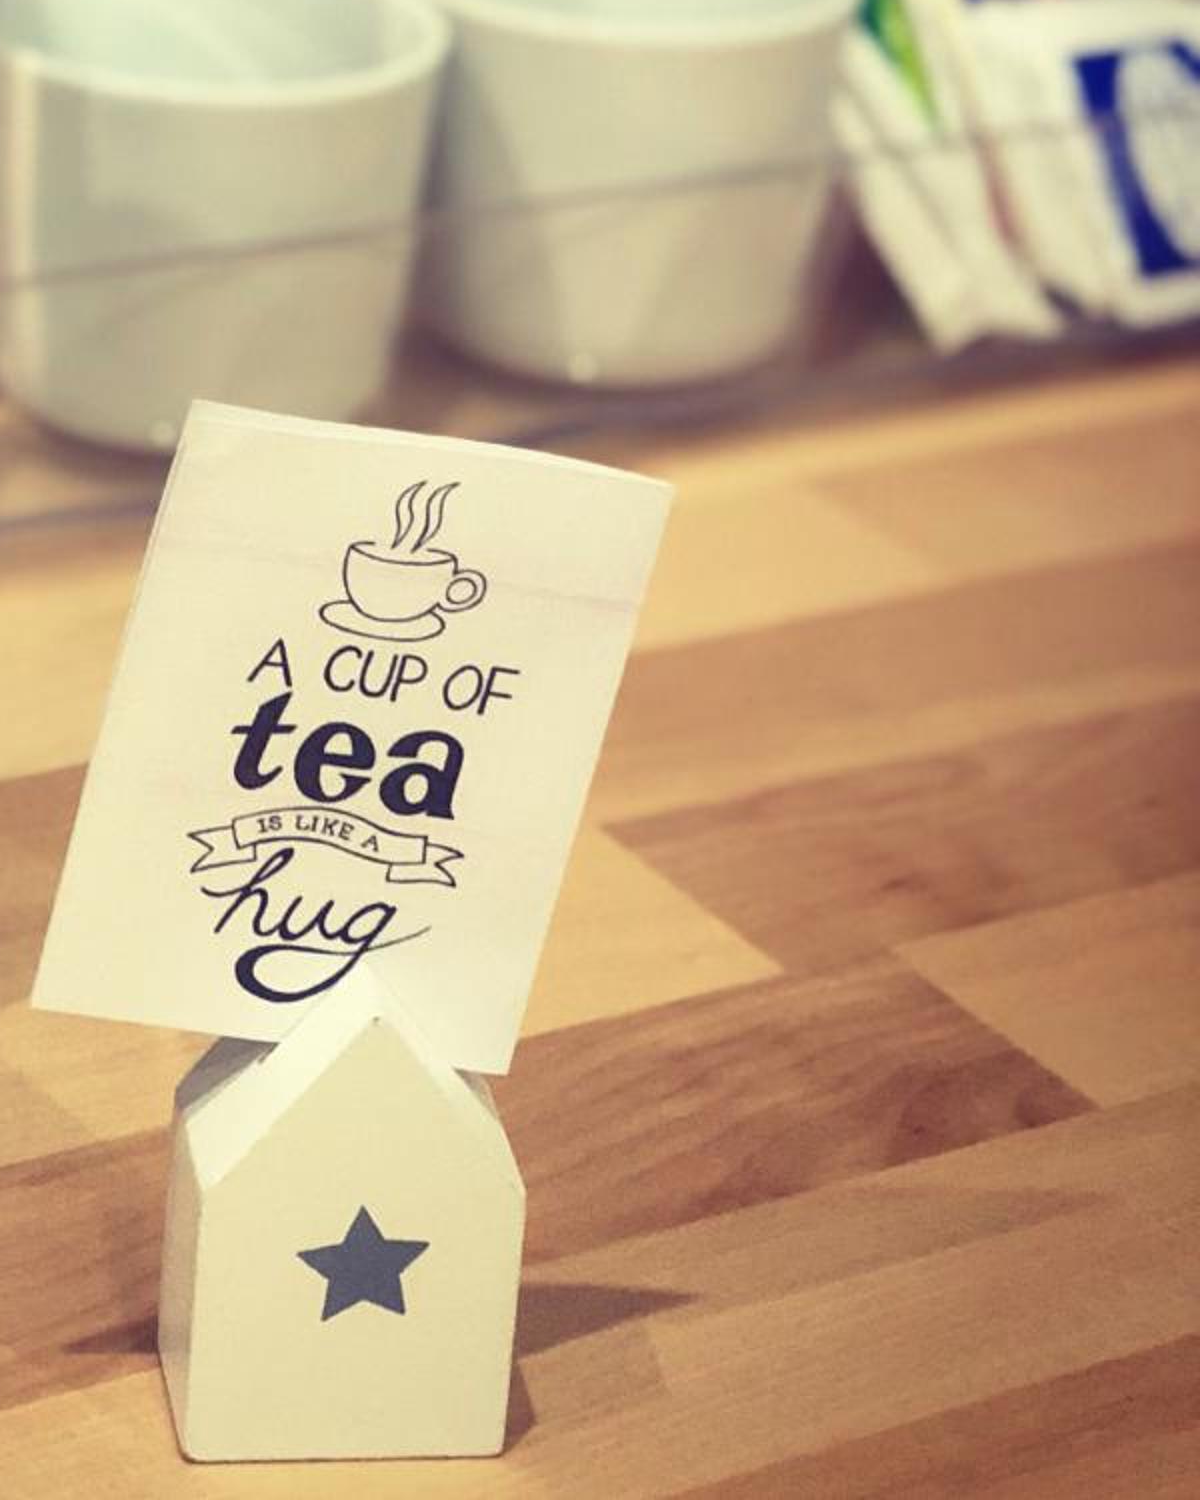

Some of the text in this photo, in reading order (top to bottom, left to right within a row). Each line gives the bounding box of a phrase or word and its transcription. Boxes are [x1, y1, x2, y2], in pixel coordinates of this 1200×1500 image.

[248, 638, 521, 716] A CUP OF
[230, 690, 465, 820] tea
[256, 814, 380, 854] IS LIKE A
[200, 847, 432, 1003] hug
